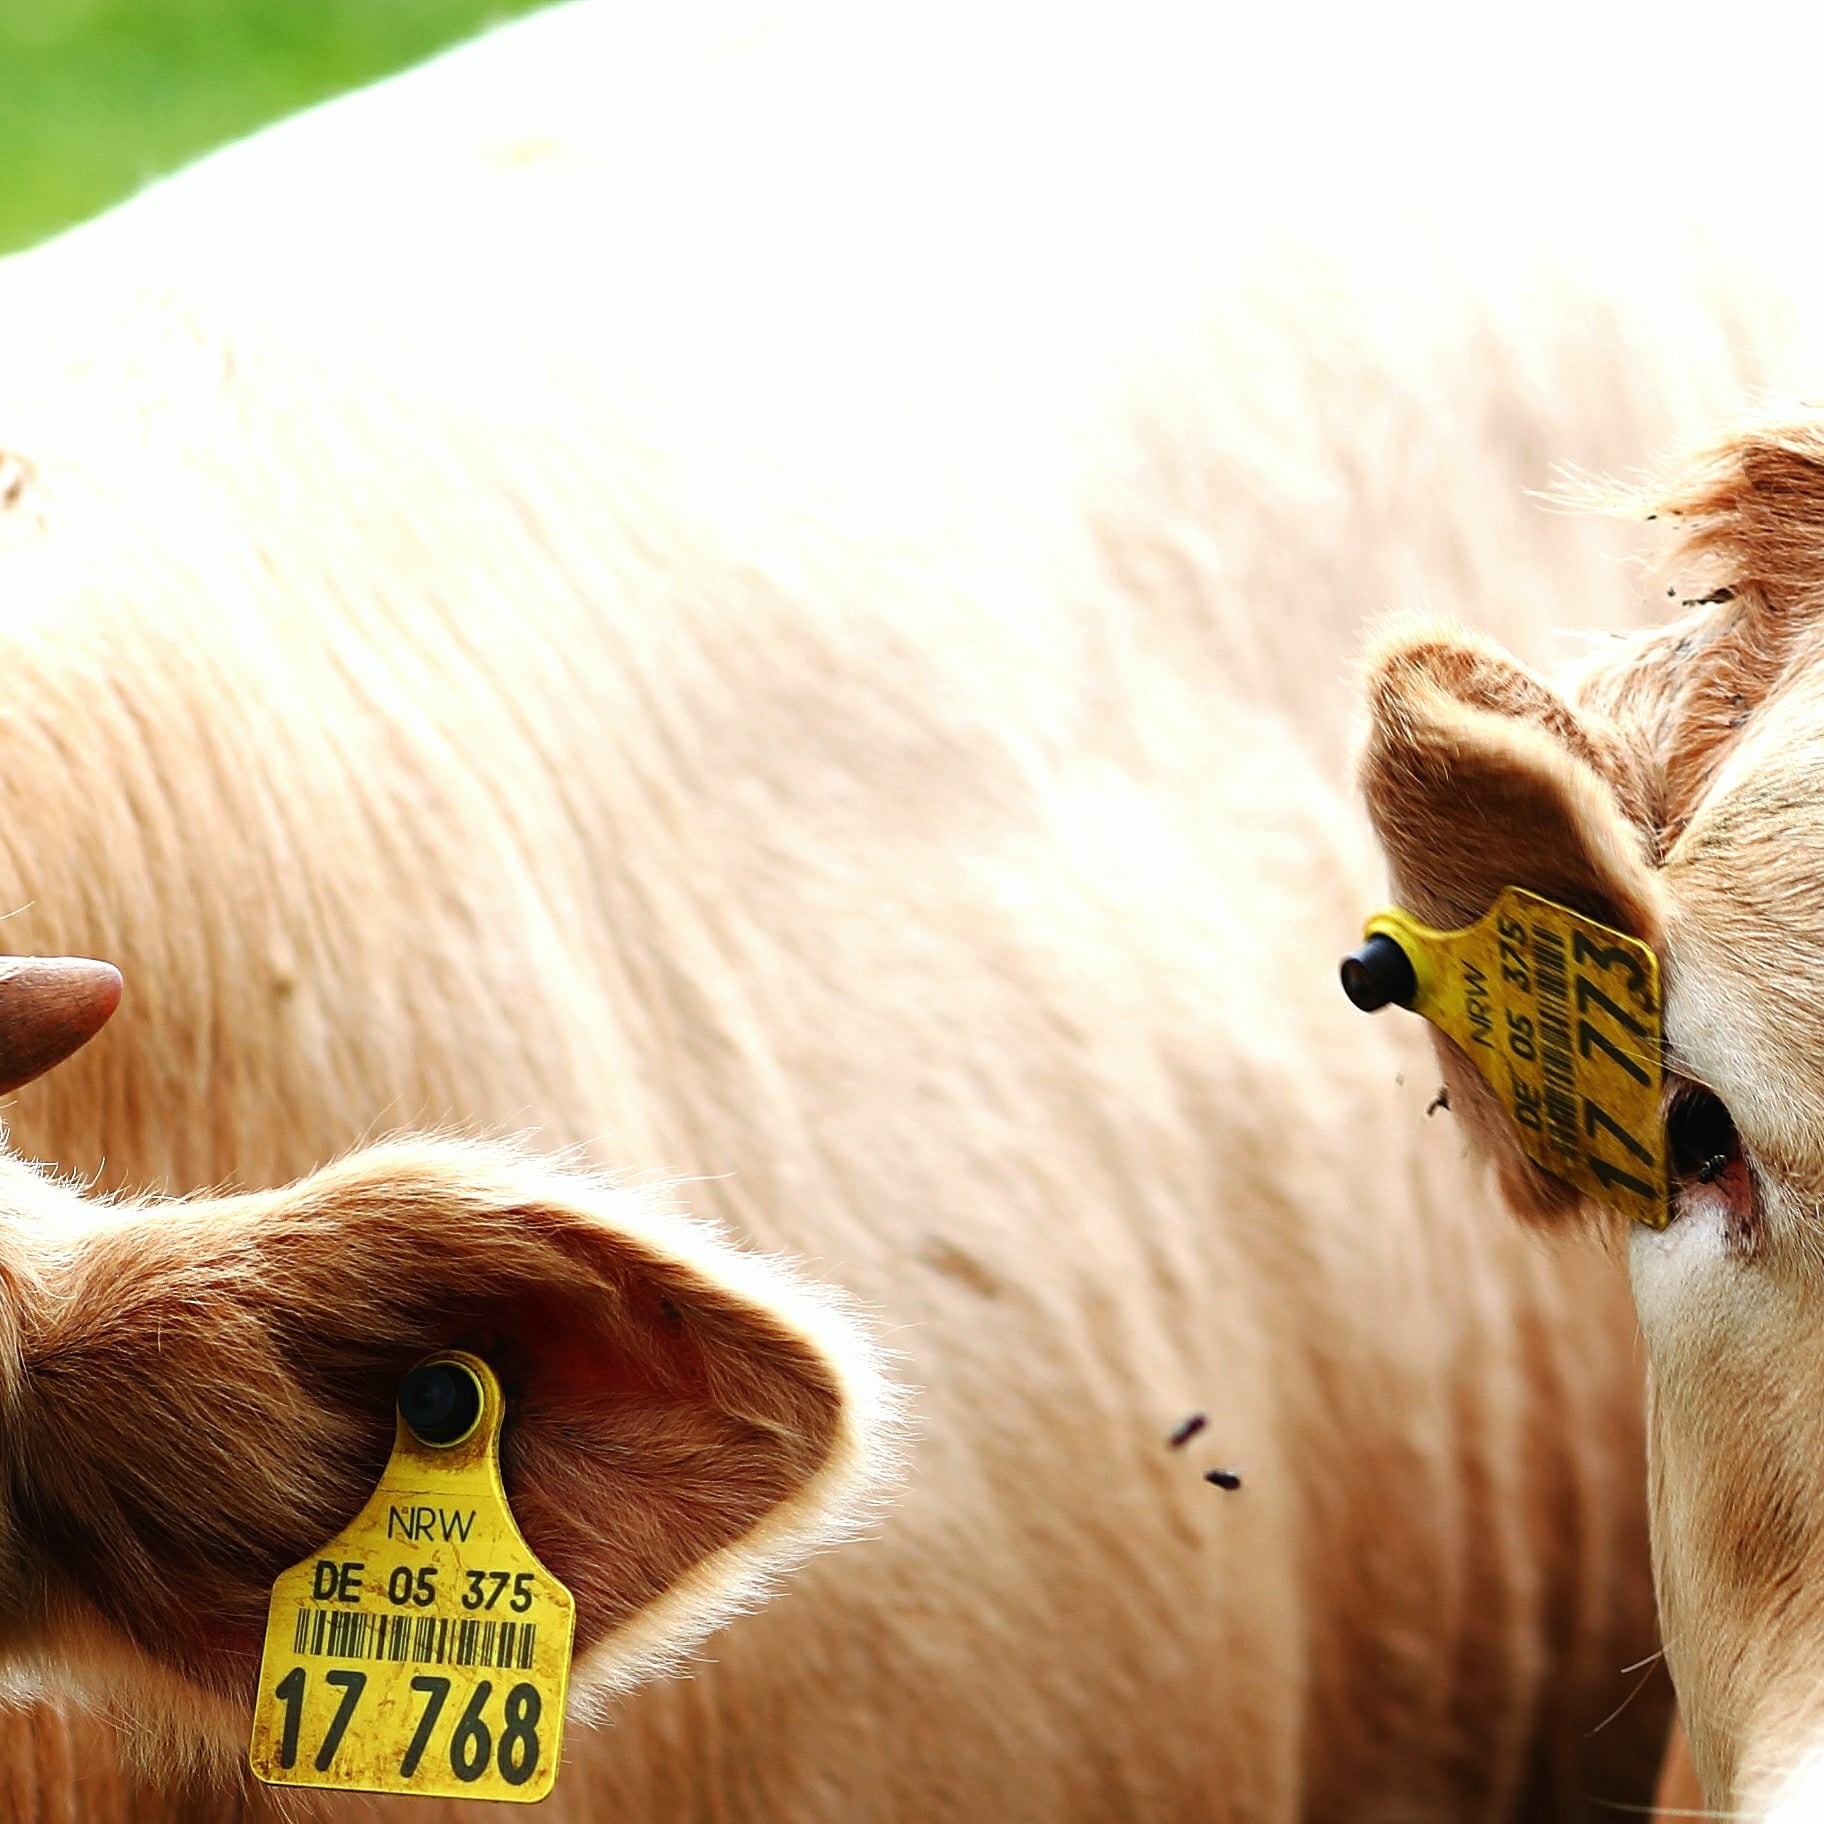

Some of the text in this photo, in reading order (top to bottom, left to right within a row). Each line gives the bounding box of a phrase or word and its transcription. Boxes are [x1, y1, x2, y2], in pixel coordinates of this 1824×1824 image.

[1462, 960, 1497, 1049] NRW
[1497, 916, 1544, 1132] DE 05 375
[1573, 927, 1661, 1202] 17 773
[387, 1505, 476, 1543] NRW
[312, 1559, 535, 1613] DE 05 375
[275, 1666, 542, 1786] 17 768
